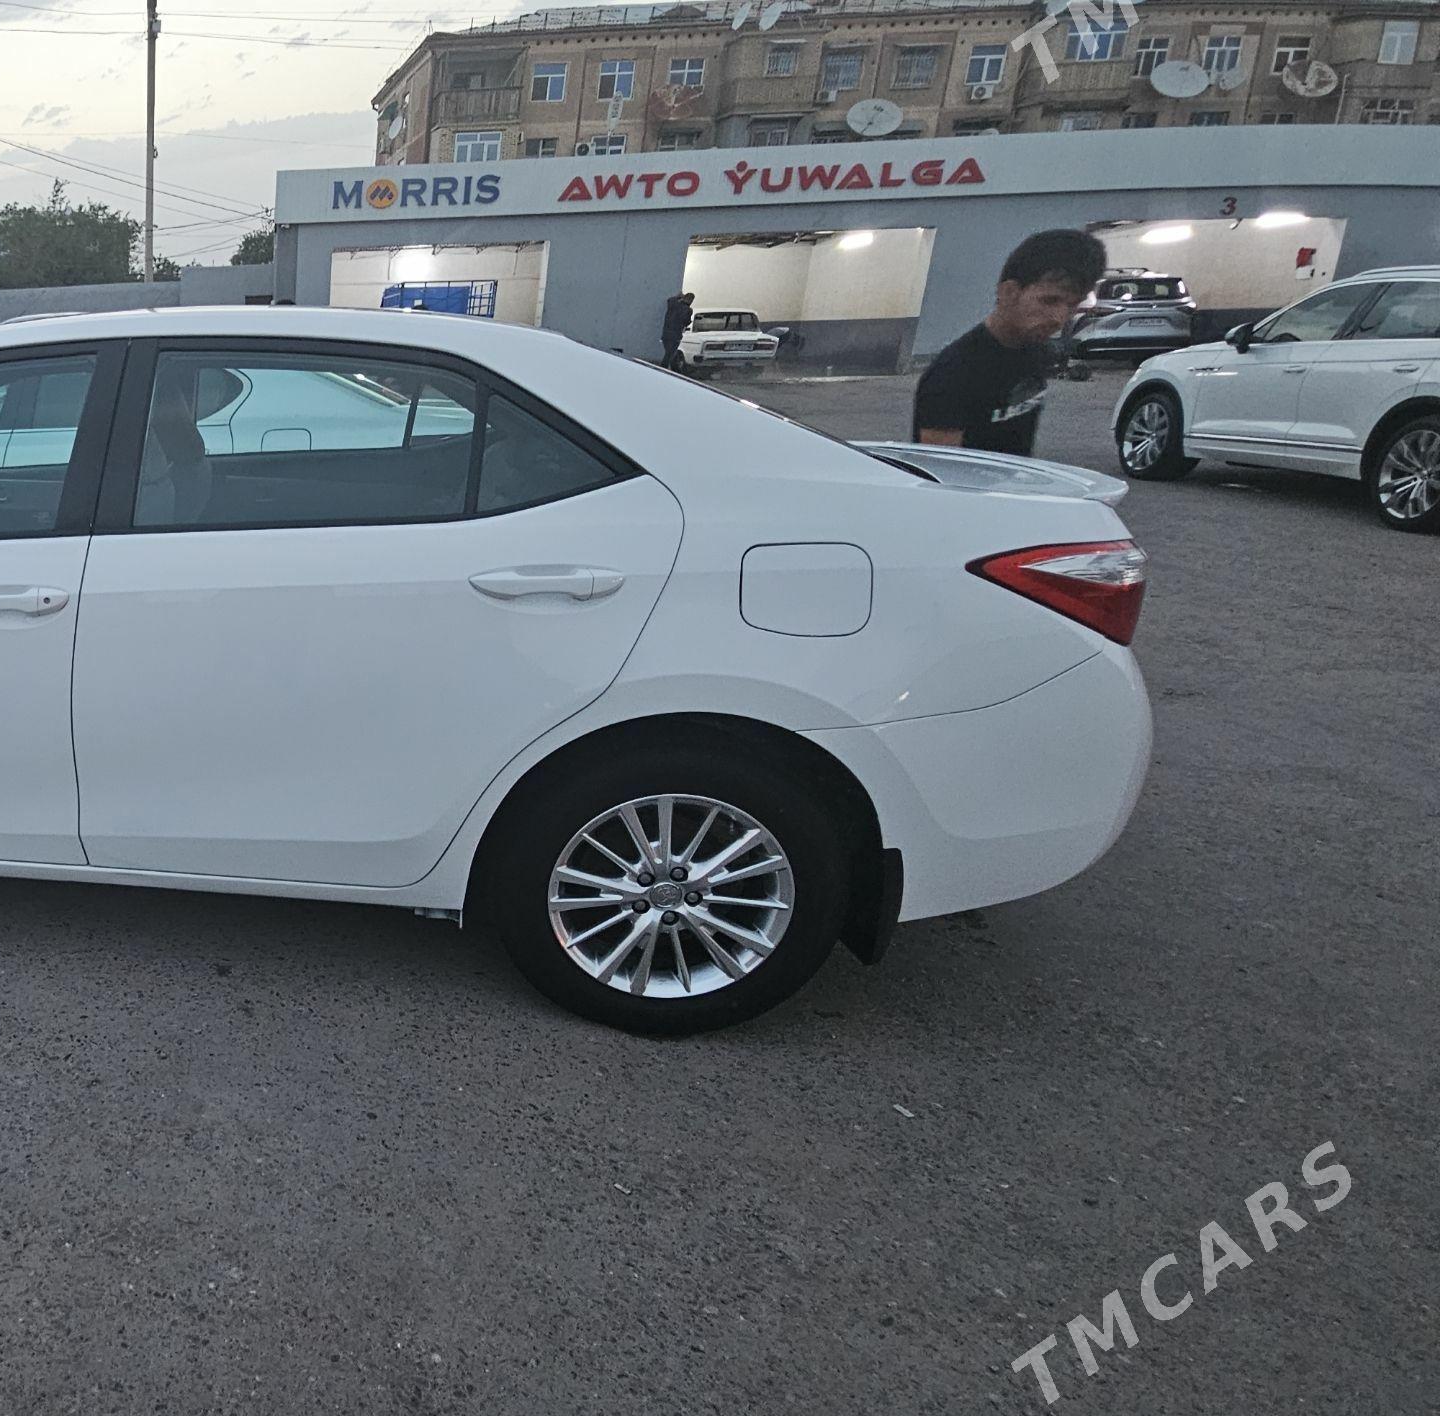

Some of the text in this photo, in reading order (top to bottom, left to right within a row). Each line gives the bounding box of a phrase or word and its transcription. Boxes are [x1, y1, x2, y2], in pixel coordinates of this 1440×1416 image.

[332, 174, 501, 209] MORRIS
[557, 170, 700, 202] AWTO
[1220, 197, 1237, 216] 3
